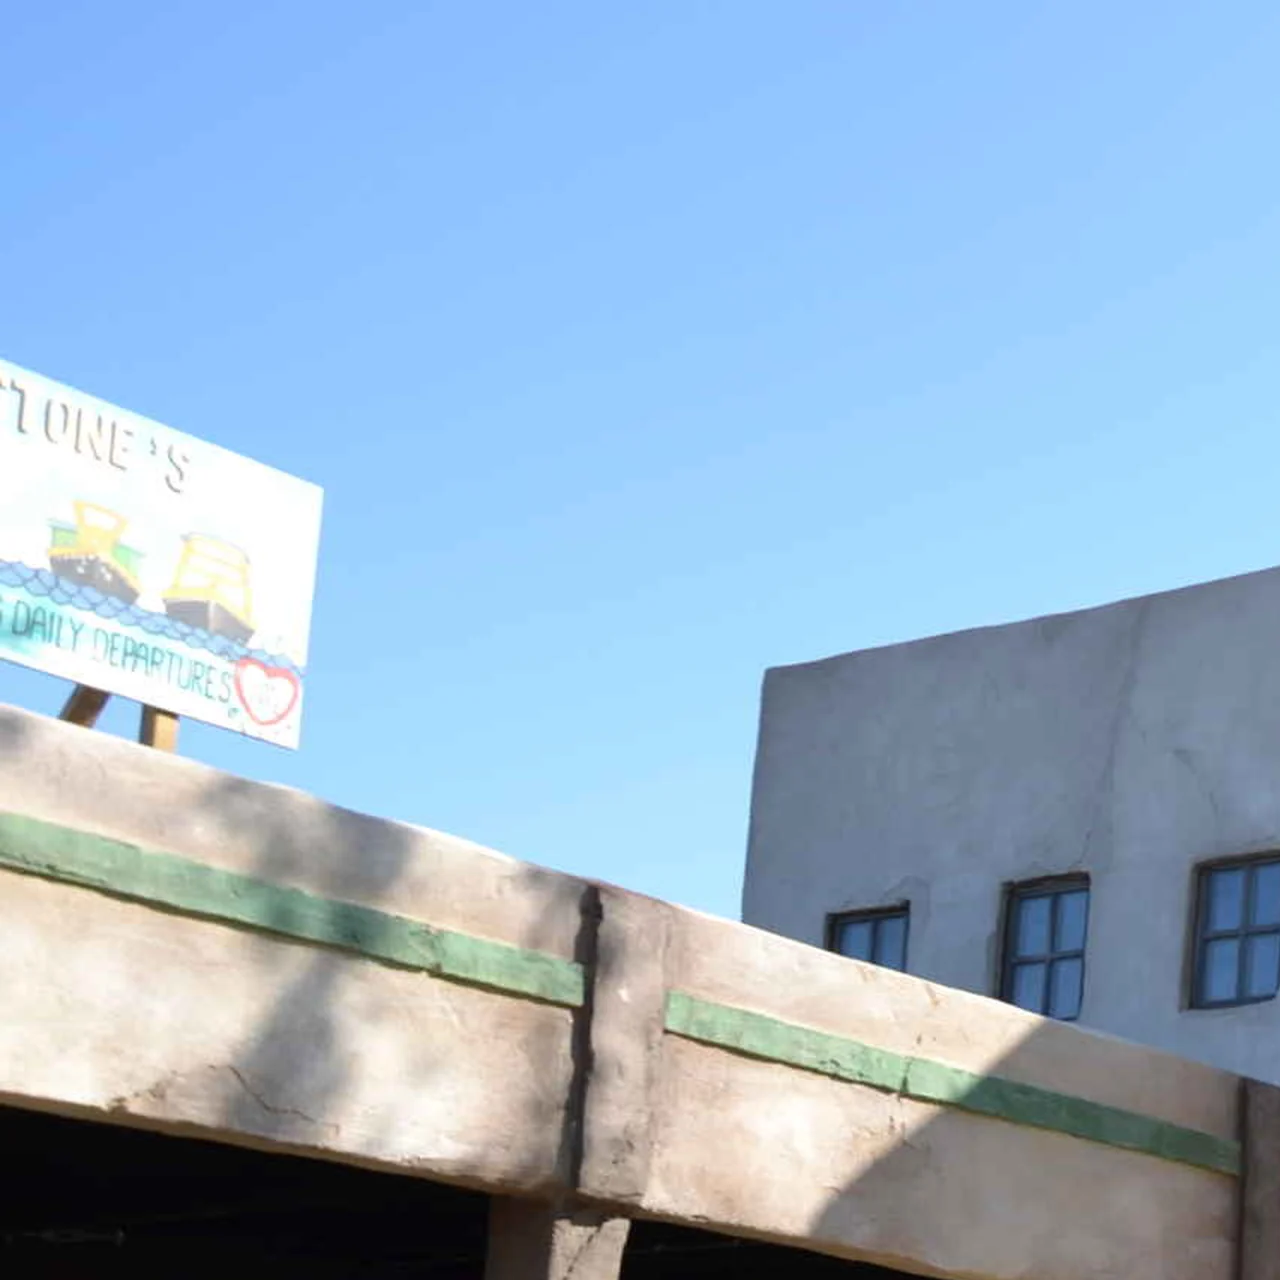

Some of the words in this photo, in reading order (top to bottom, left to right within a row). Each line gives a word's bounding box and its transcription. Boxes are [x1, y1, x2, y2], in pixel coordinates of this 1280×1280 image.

[0, 376, 190, 494] TONE'S
[11, 599, 84, 653] DAILY
[91, 627, 235, 704] DEPARTURES
